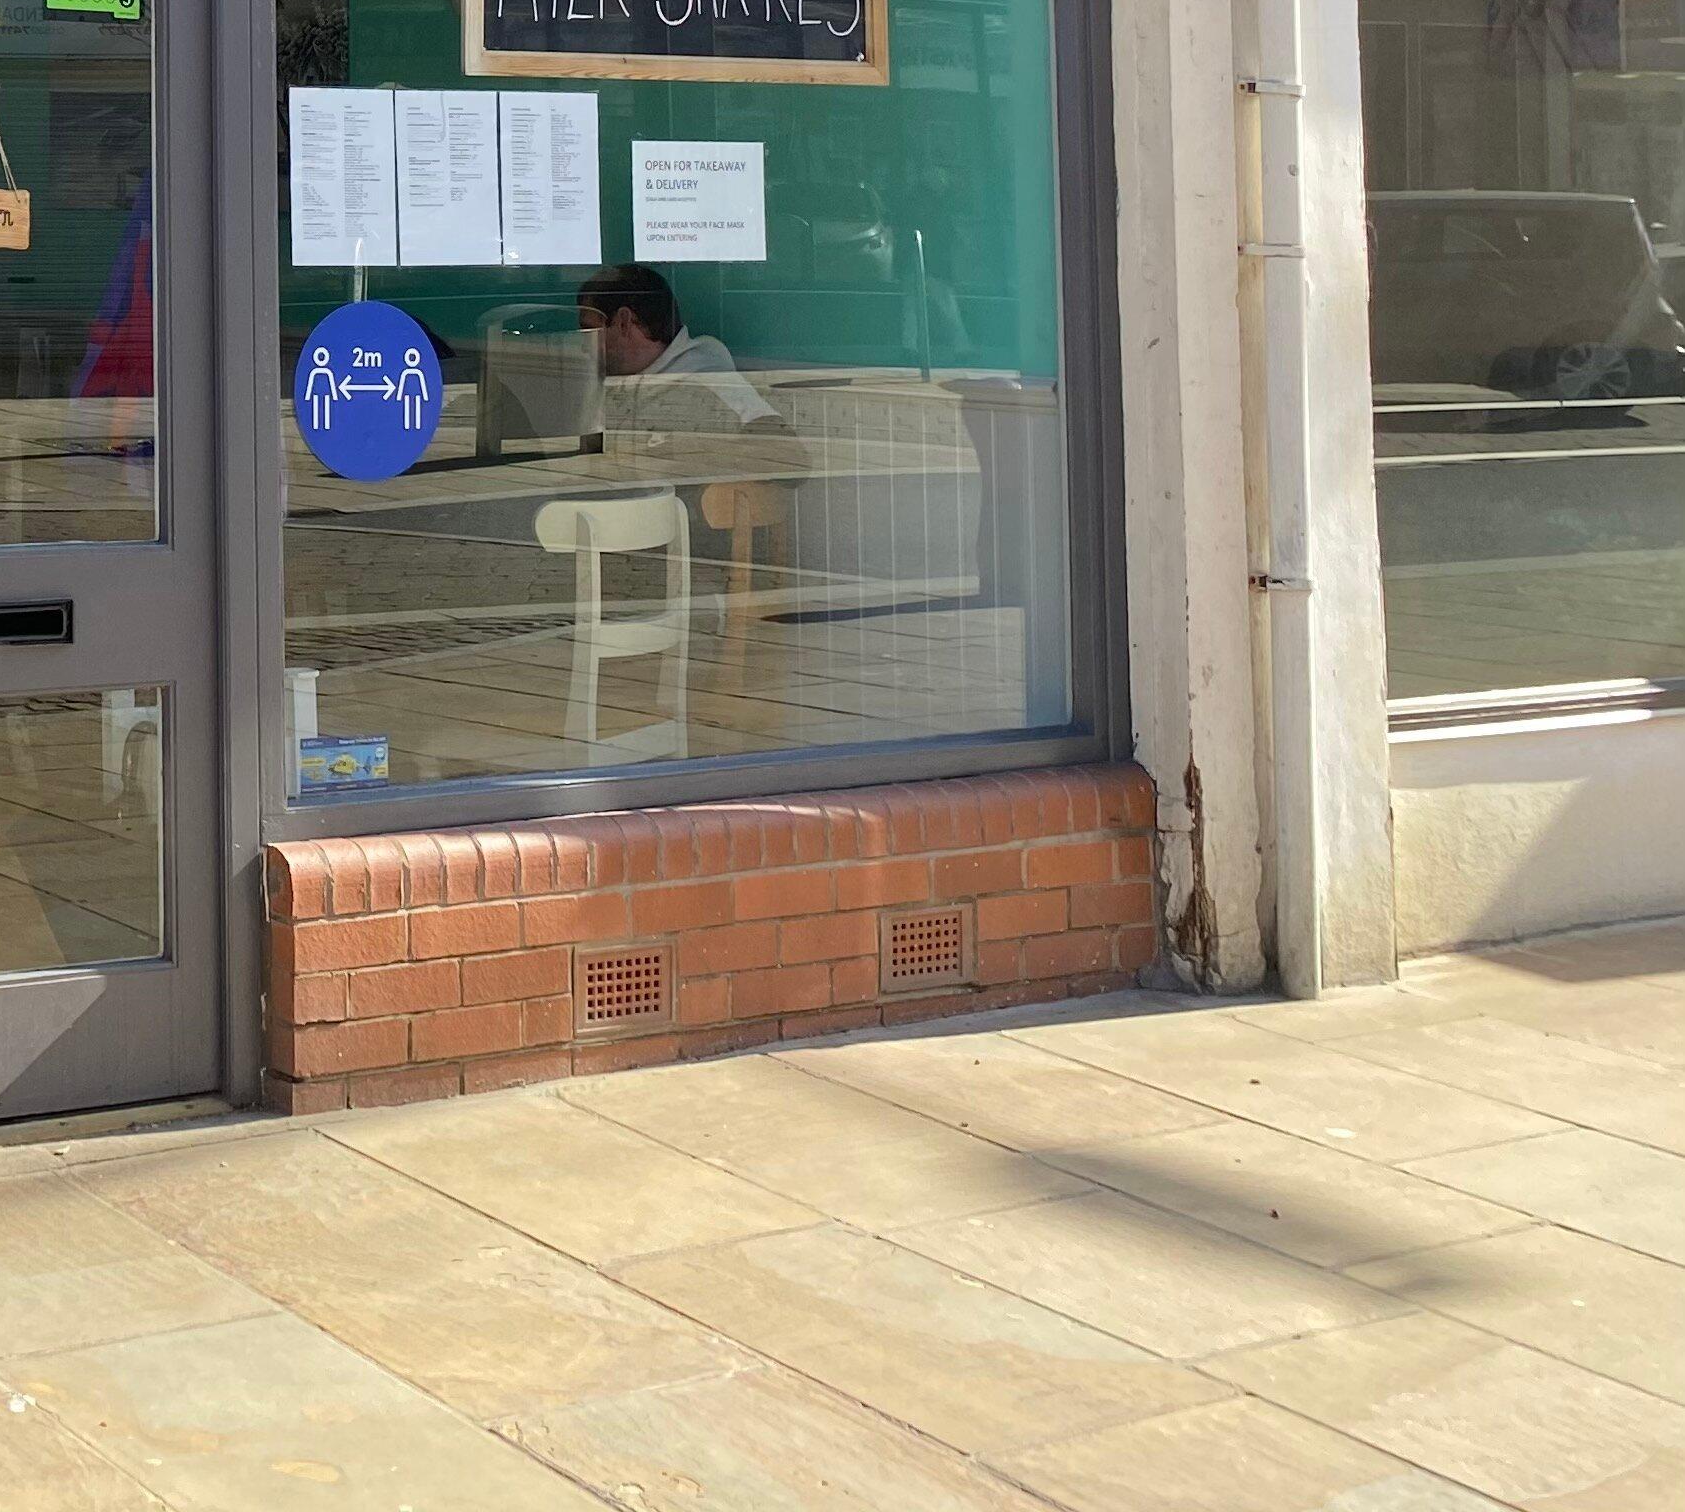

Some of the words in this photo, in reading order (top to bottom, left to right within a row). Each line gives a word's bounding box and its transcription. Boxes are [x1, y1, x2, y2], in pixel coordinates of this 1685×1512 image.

[645, 160, 671, 171] OPEN
[673, 160, 692, 171] FOR
[694, 161, 746, 172] TAKEAWAY
[646, 179, 653, 189] &
[656, 179, 698, 190] DELIVERY
[646, 221, 668, 229] PLEASE
[670, 221, 689, 229] WEAR
[690, 221, 707, 229] YOUR
[709, 221, 724, 229] FACE
[727, 221, 745, 229] MASK
[646, 234, 666, 242] UPON
[667, 234, 698, 242] ENTERING
[352, 347, 382, 368] 2m
